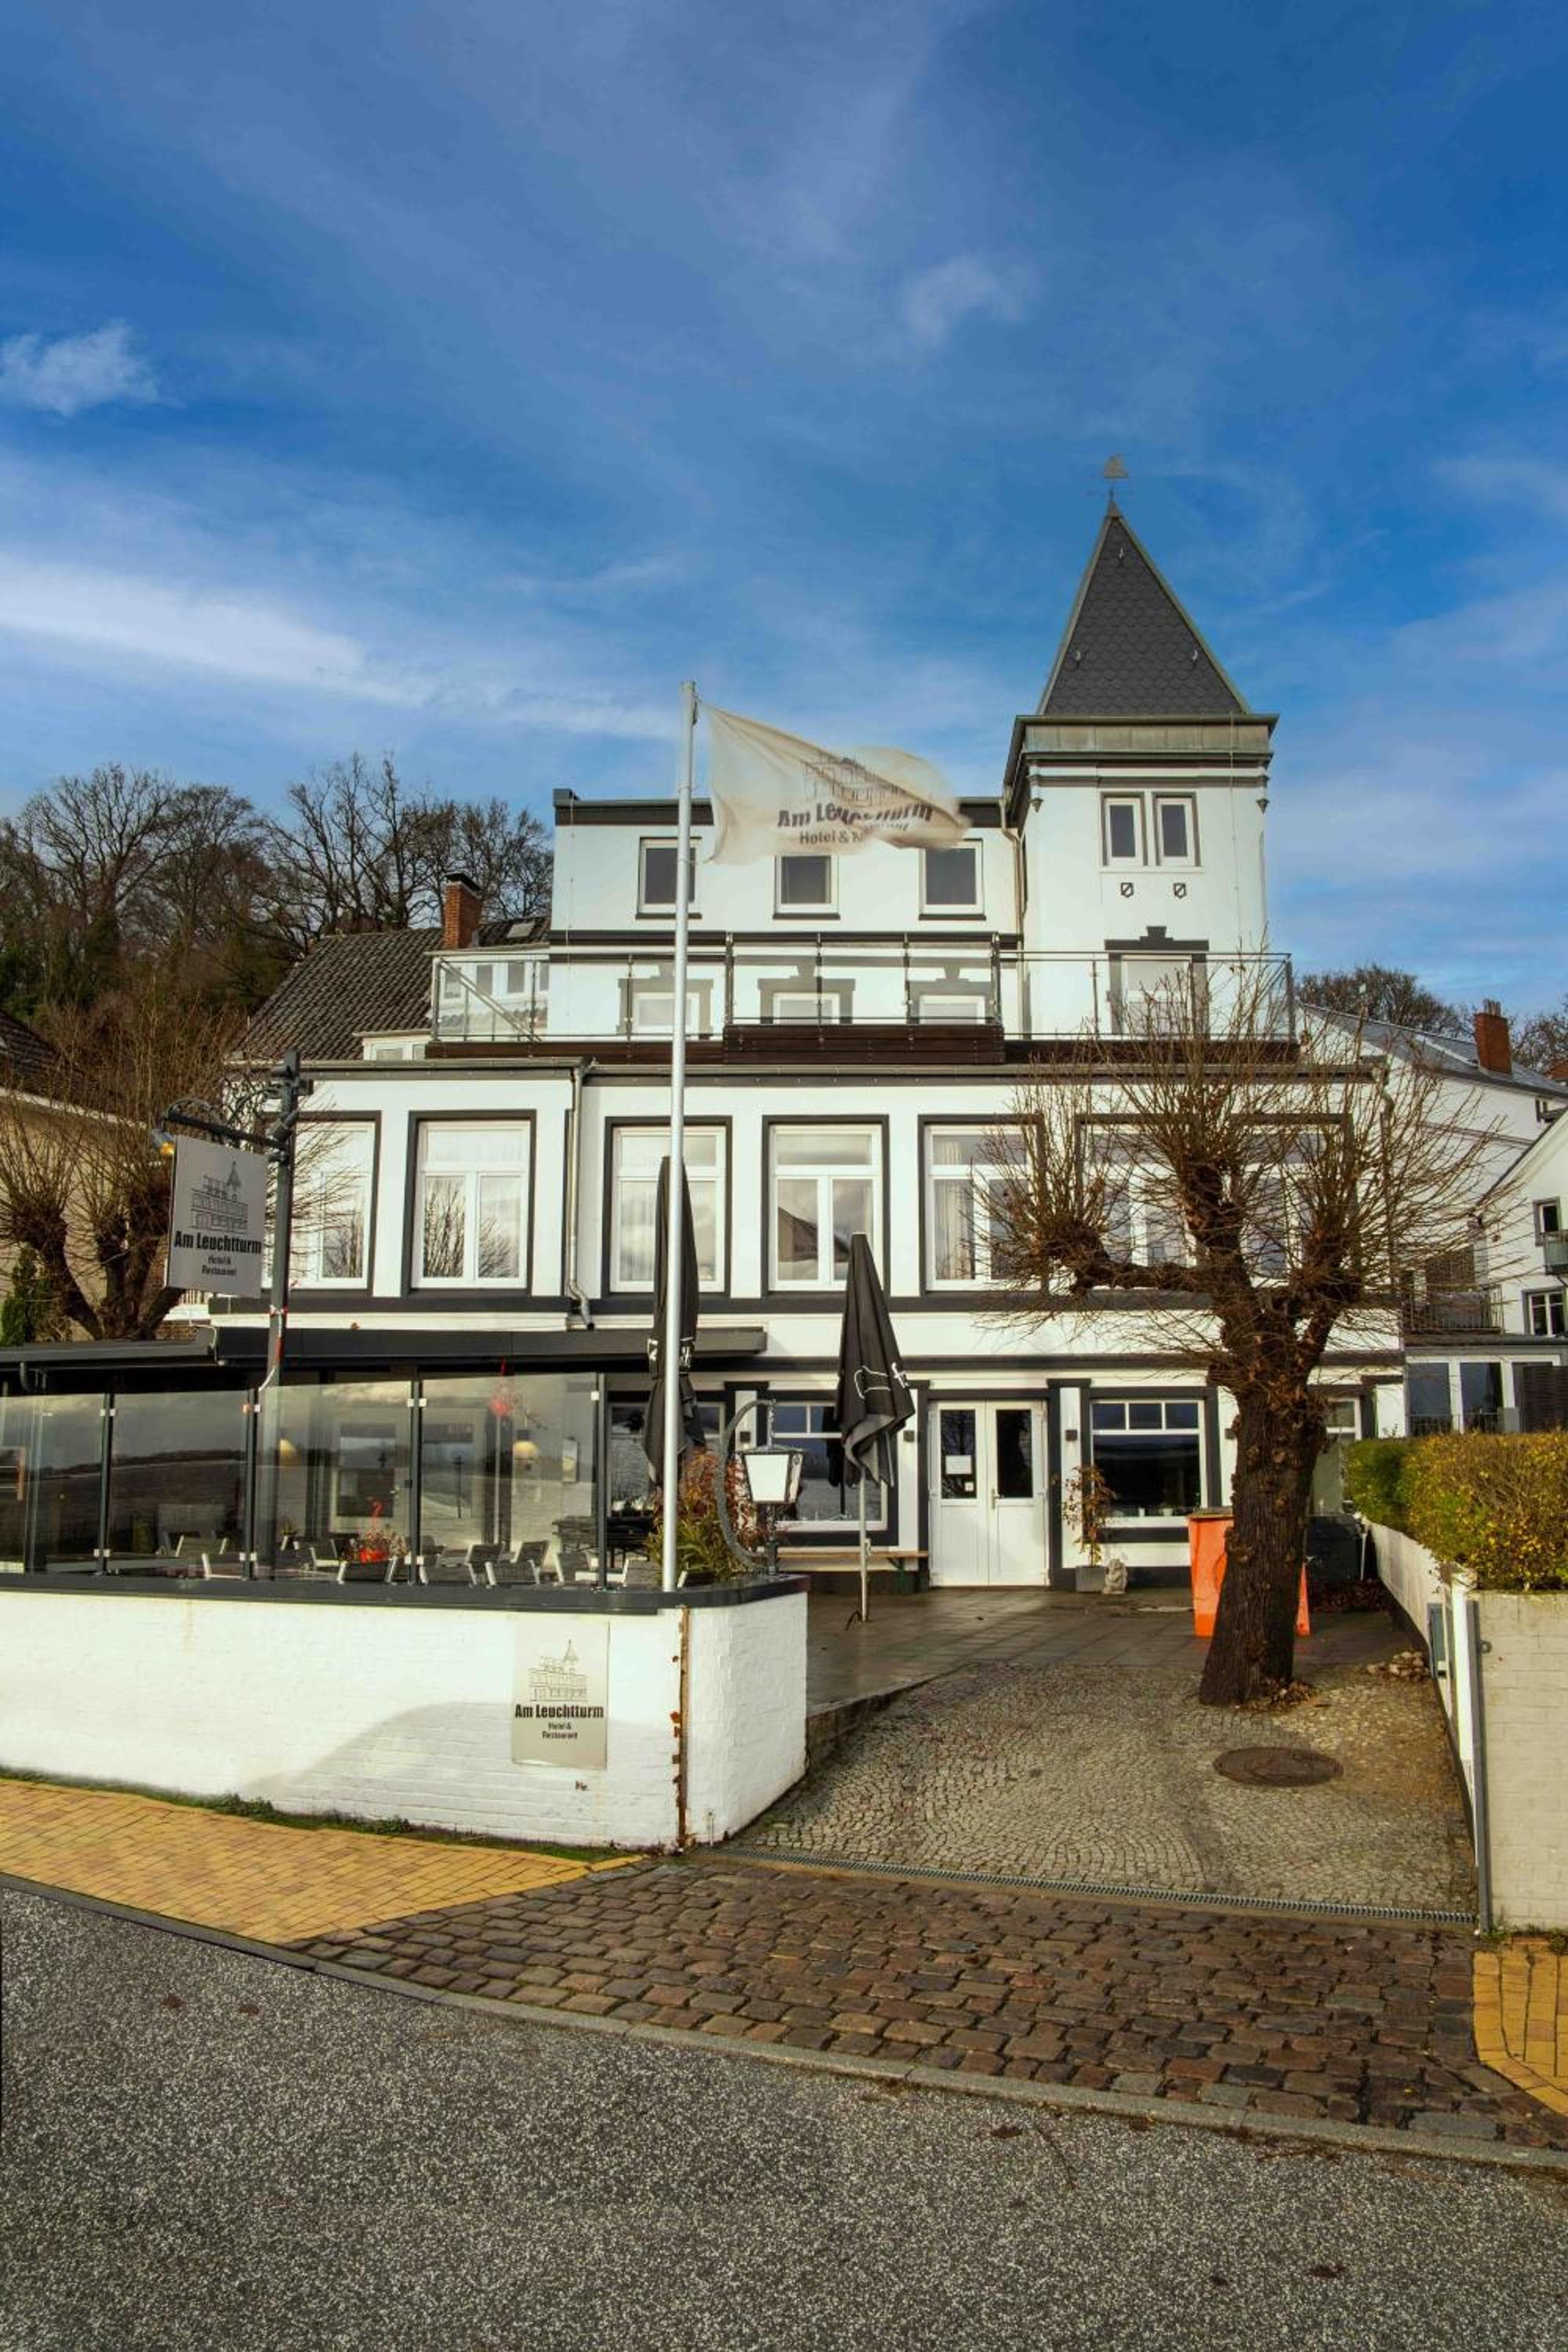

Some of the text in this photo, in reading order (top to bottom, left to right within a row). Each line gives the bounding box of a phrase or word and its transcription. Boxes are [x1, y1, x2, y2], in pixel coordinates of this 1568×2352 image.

[778, 802, 934, 827] Am Leuurm
[800, 829, 835, 844] Hotel
[838, 830, 848, 843] &
[174, 1231, 262, 1254] Am Leuchtturm
[515, 1704, 604, 1719] Am Leuchtturm
